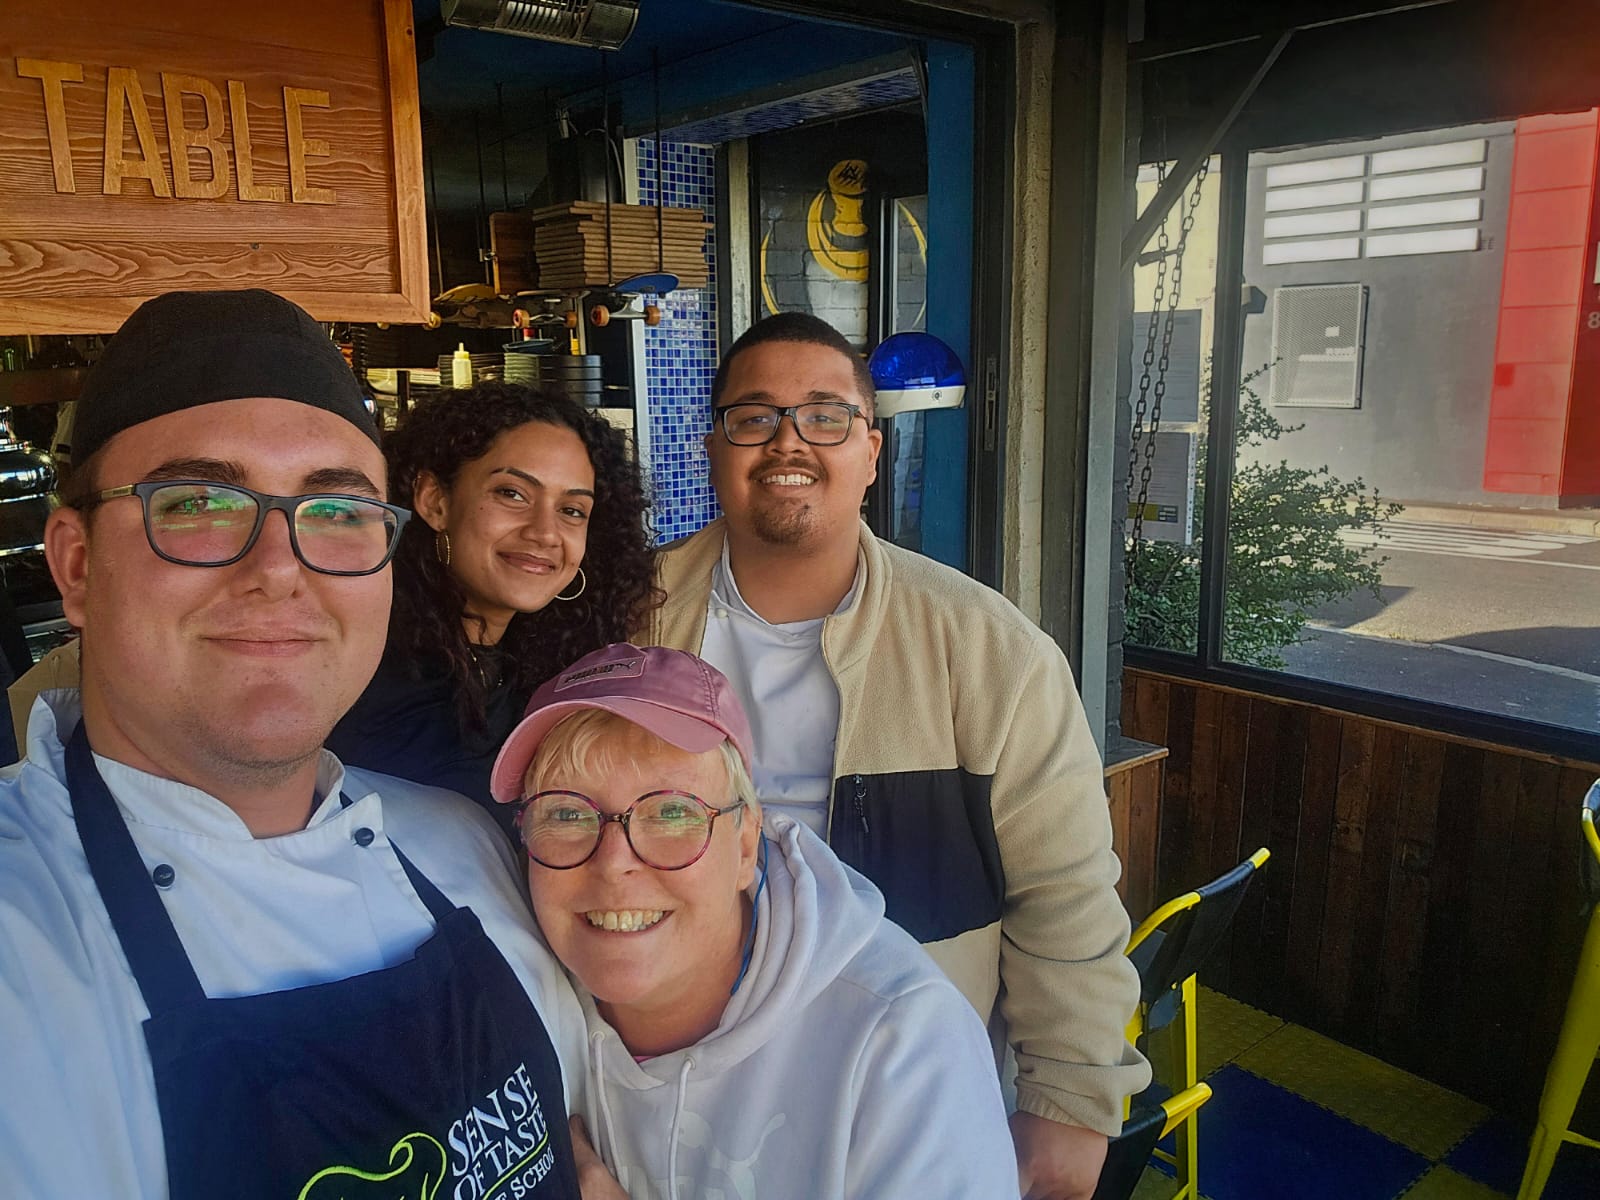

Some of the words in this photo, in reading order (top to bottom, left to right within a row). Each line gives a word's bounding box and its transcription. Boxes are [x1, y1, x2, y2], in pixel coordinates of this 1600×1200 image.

[16, 57, 336, 204] TABLE
[448, 1062, 538, 1176] SENSE
[485, 1101, 546, 1177] TASTE
